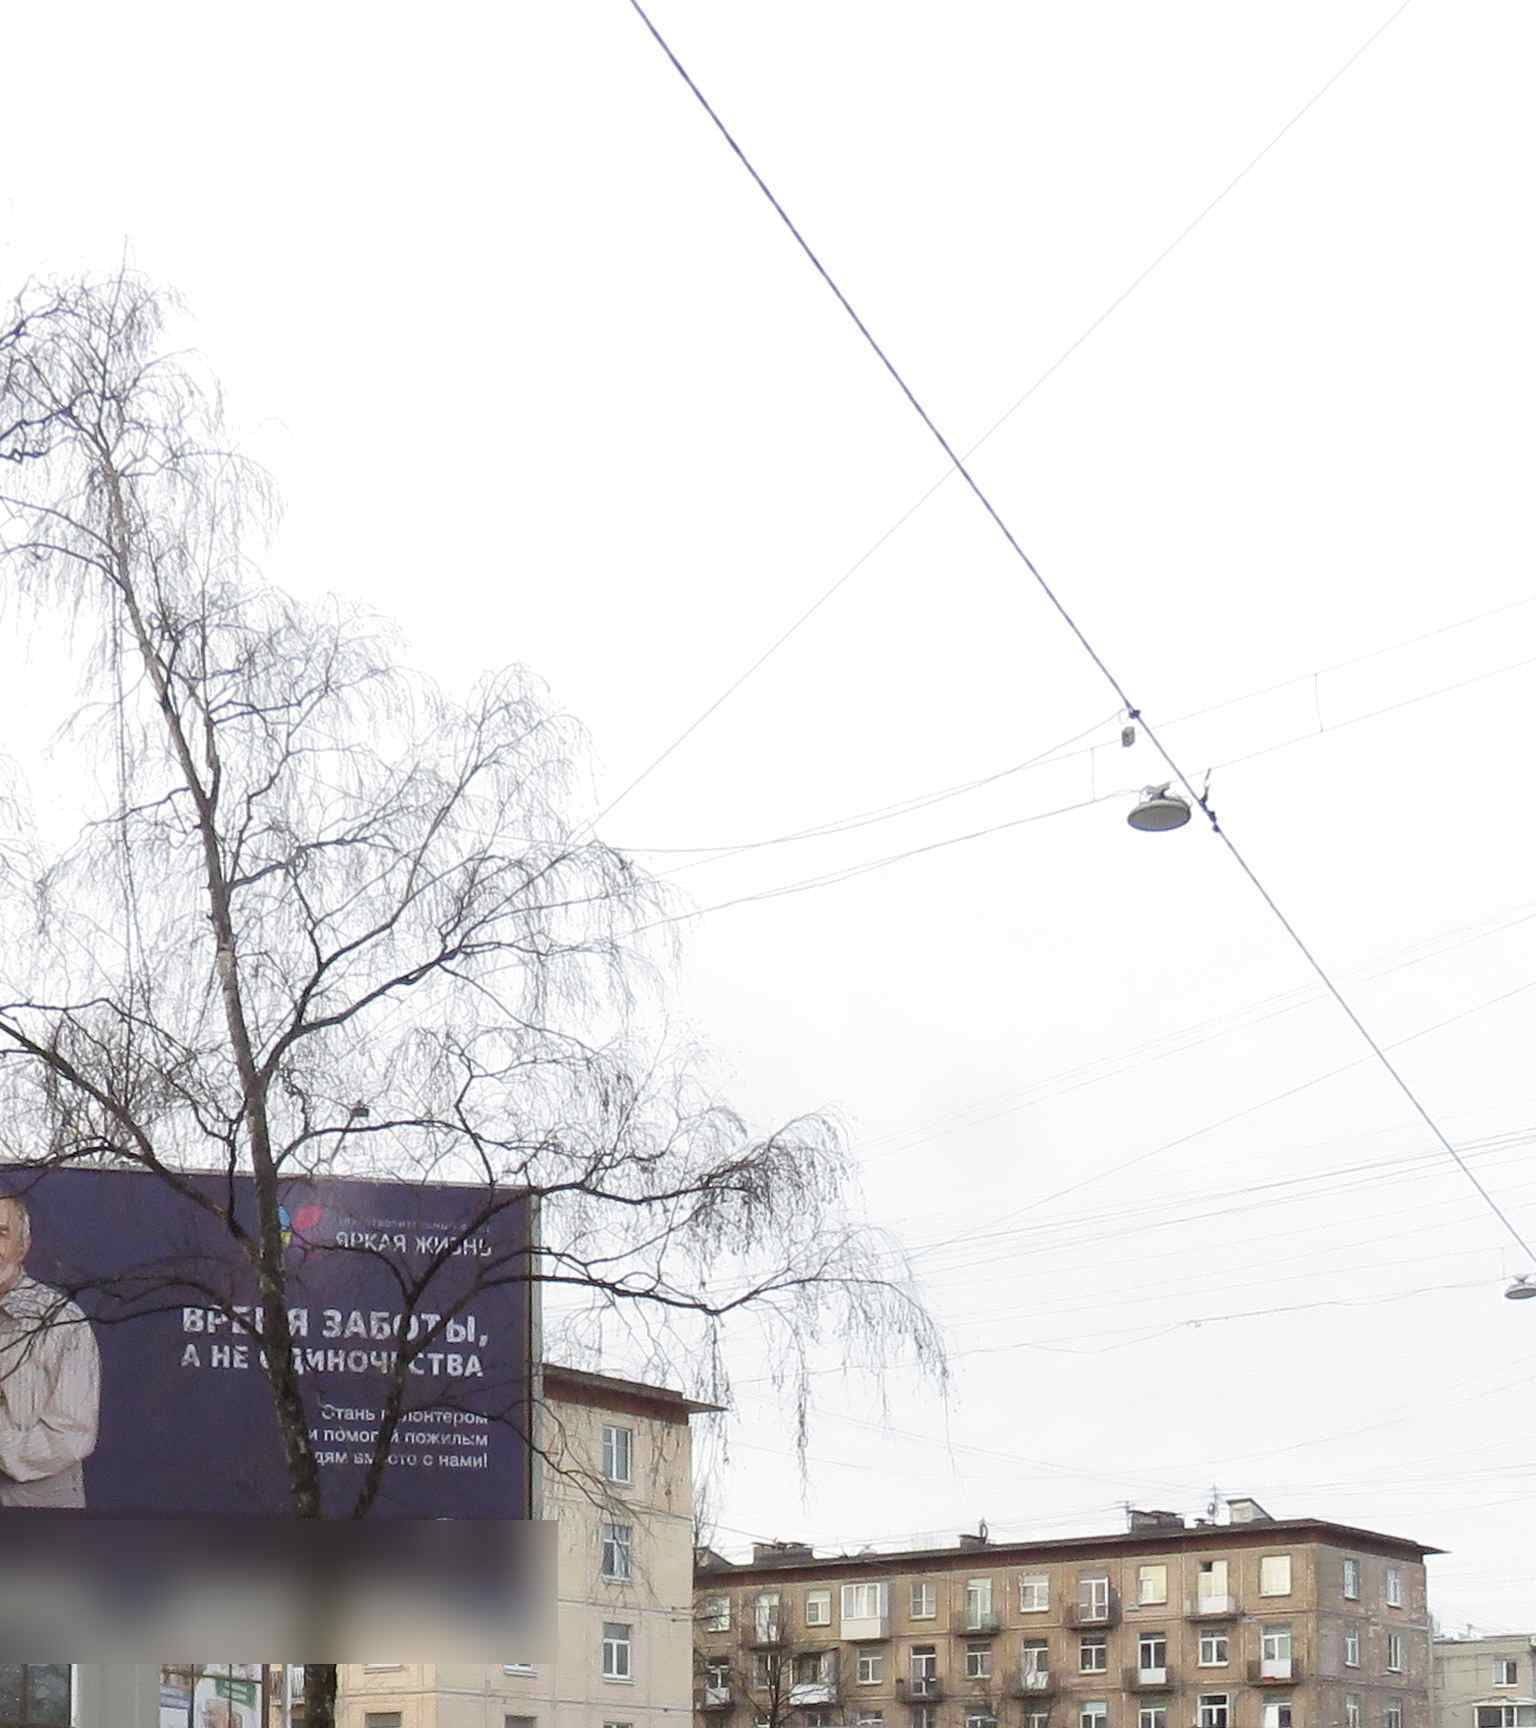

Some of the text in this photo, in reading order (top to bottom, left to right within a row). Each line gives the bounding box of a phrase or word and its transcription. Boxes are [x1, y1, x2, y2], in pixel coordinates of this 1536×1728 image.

[336, 1231, 407, 1253] ЯРКАЯ
[182, 1306, 309, 1337] ВРЕЯ
[181, 1344, 484, 1377] А НЕ ДИНОЧСТВА
[321, 1404, 489, 1428] Стань лонтером
[324, 1428, 399, 1446] помогй
[405, 1431, 489, 1448] пожилым
[354, 1452, 417, 1467] вмсте
[423, 1456, 433, 1468] с
[439, 1452, 489, 1469] нами!
